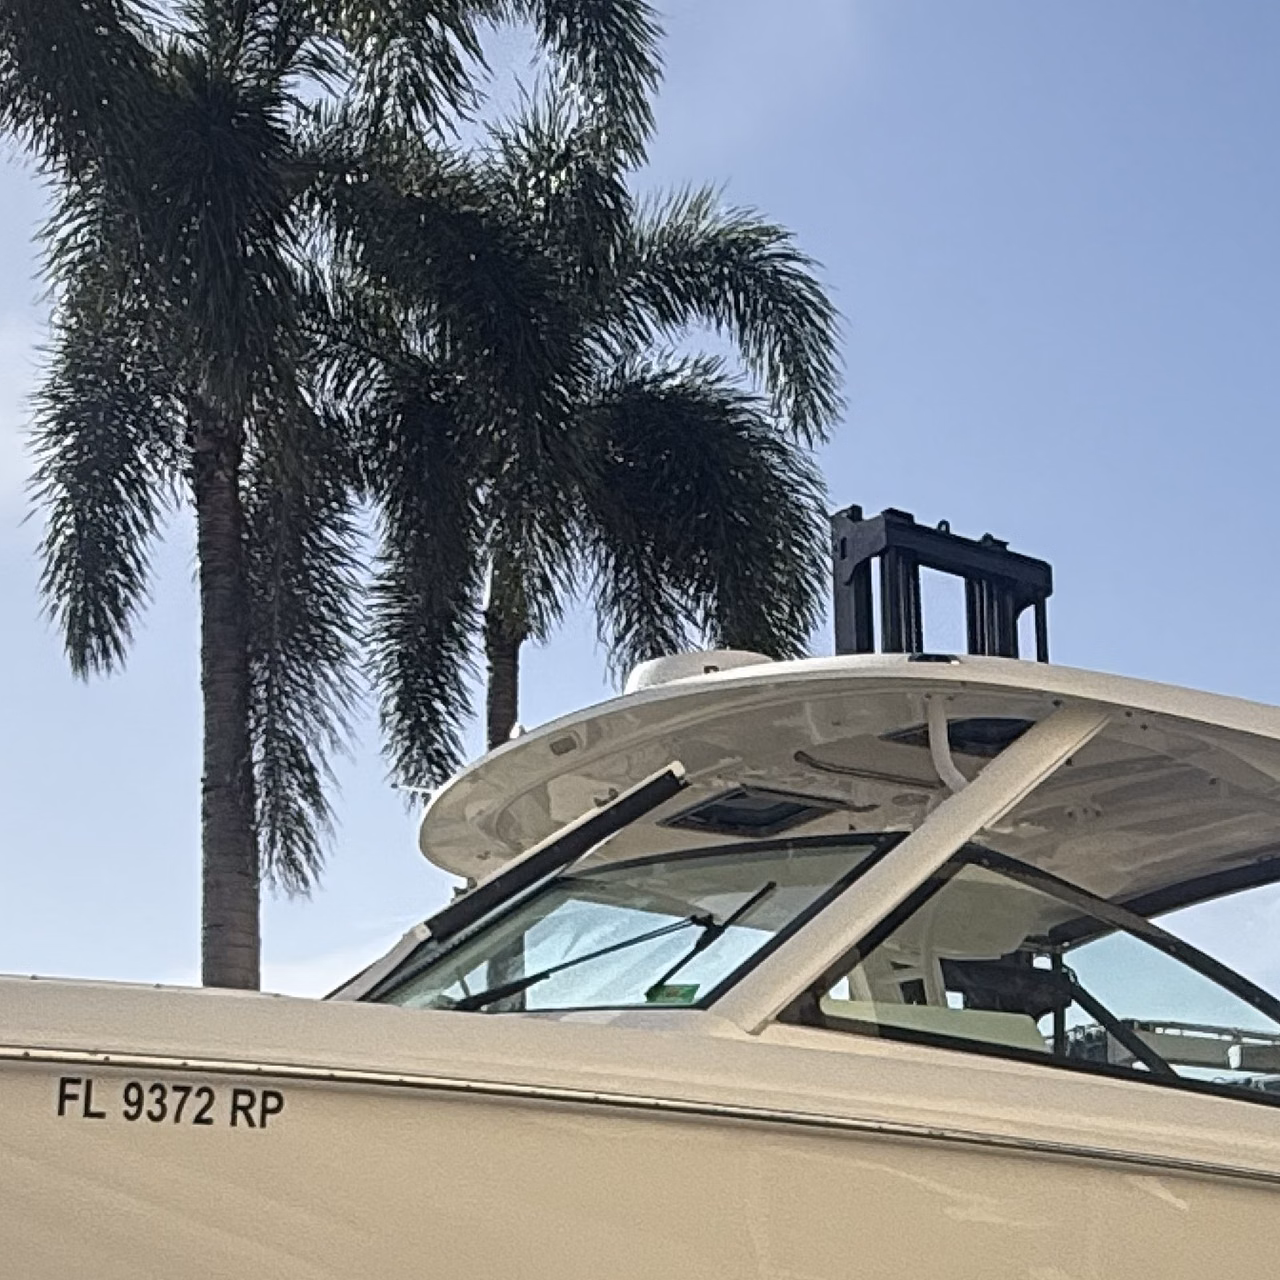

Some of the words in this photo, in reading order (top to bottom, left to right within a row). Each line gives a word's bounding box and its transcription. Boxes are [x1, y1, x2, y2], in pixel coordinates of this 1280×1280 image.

[57, 1076, 107, 1120] FL
[122, 1081, 216, 1125] 9372
[229, 1088, 285, 1129] RP
